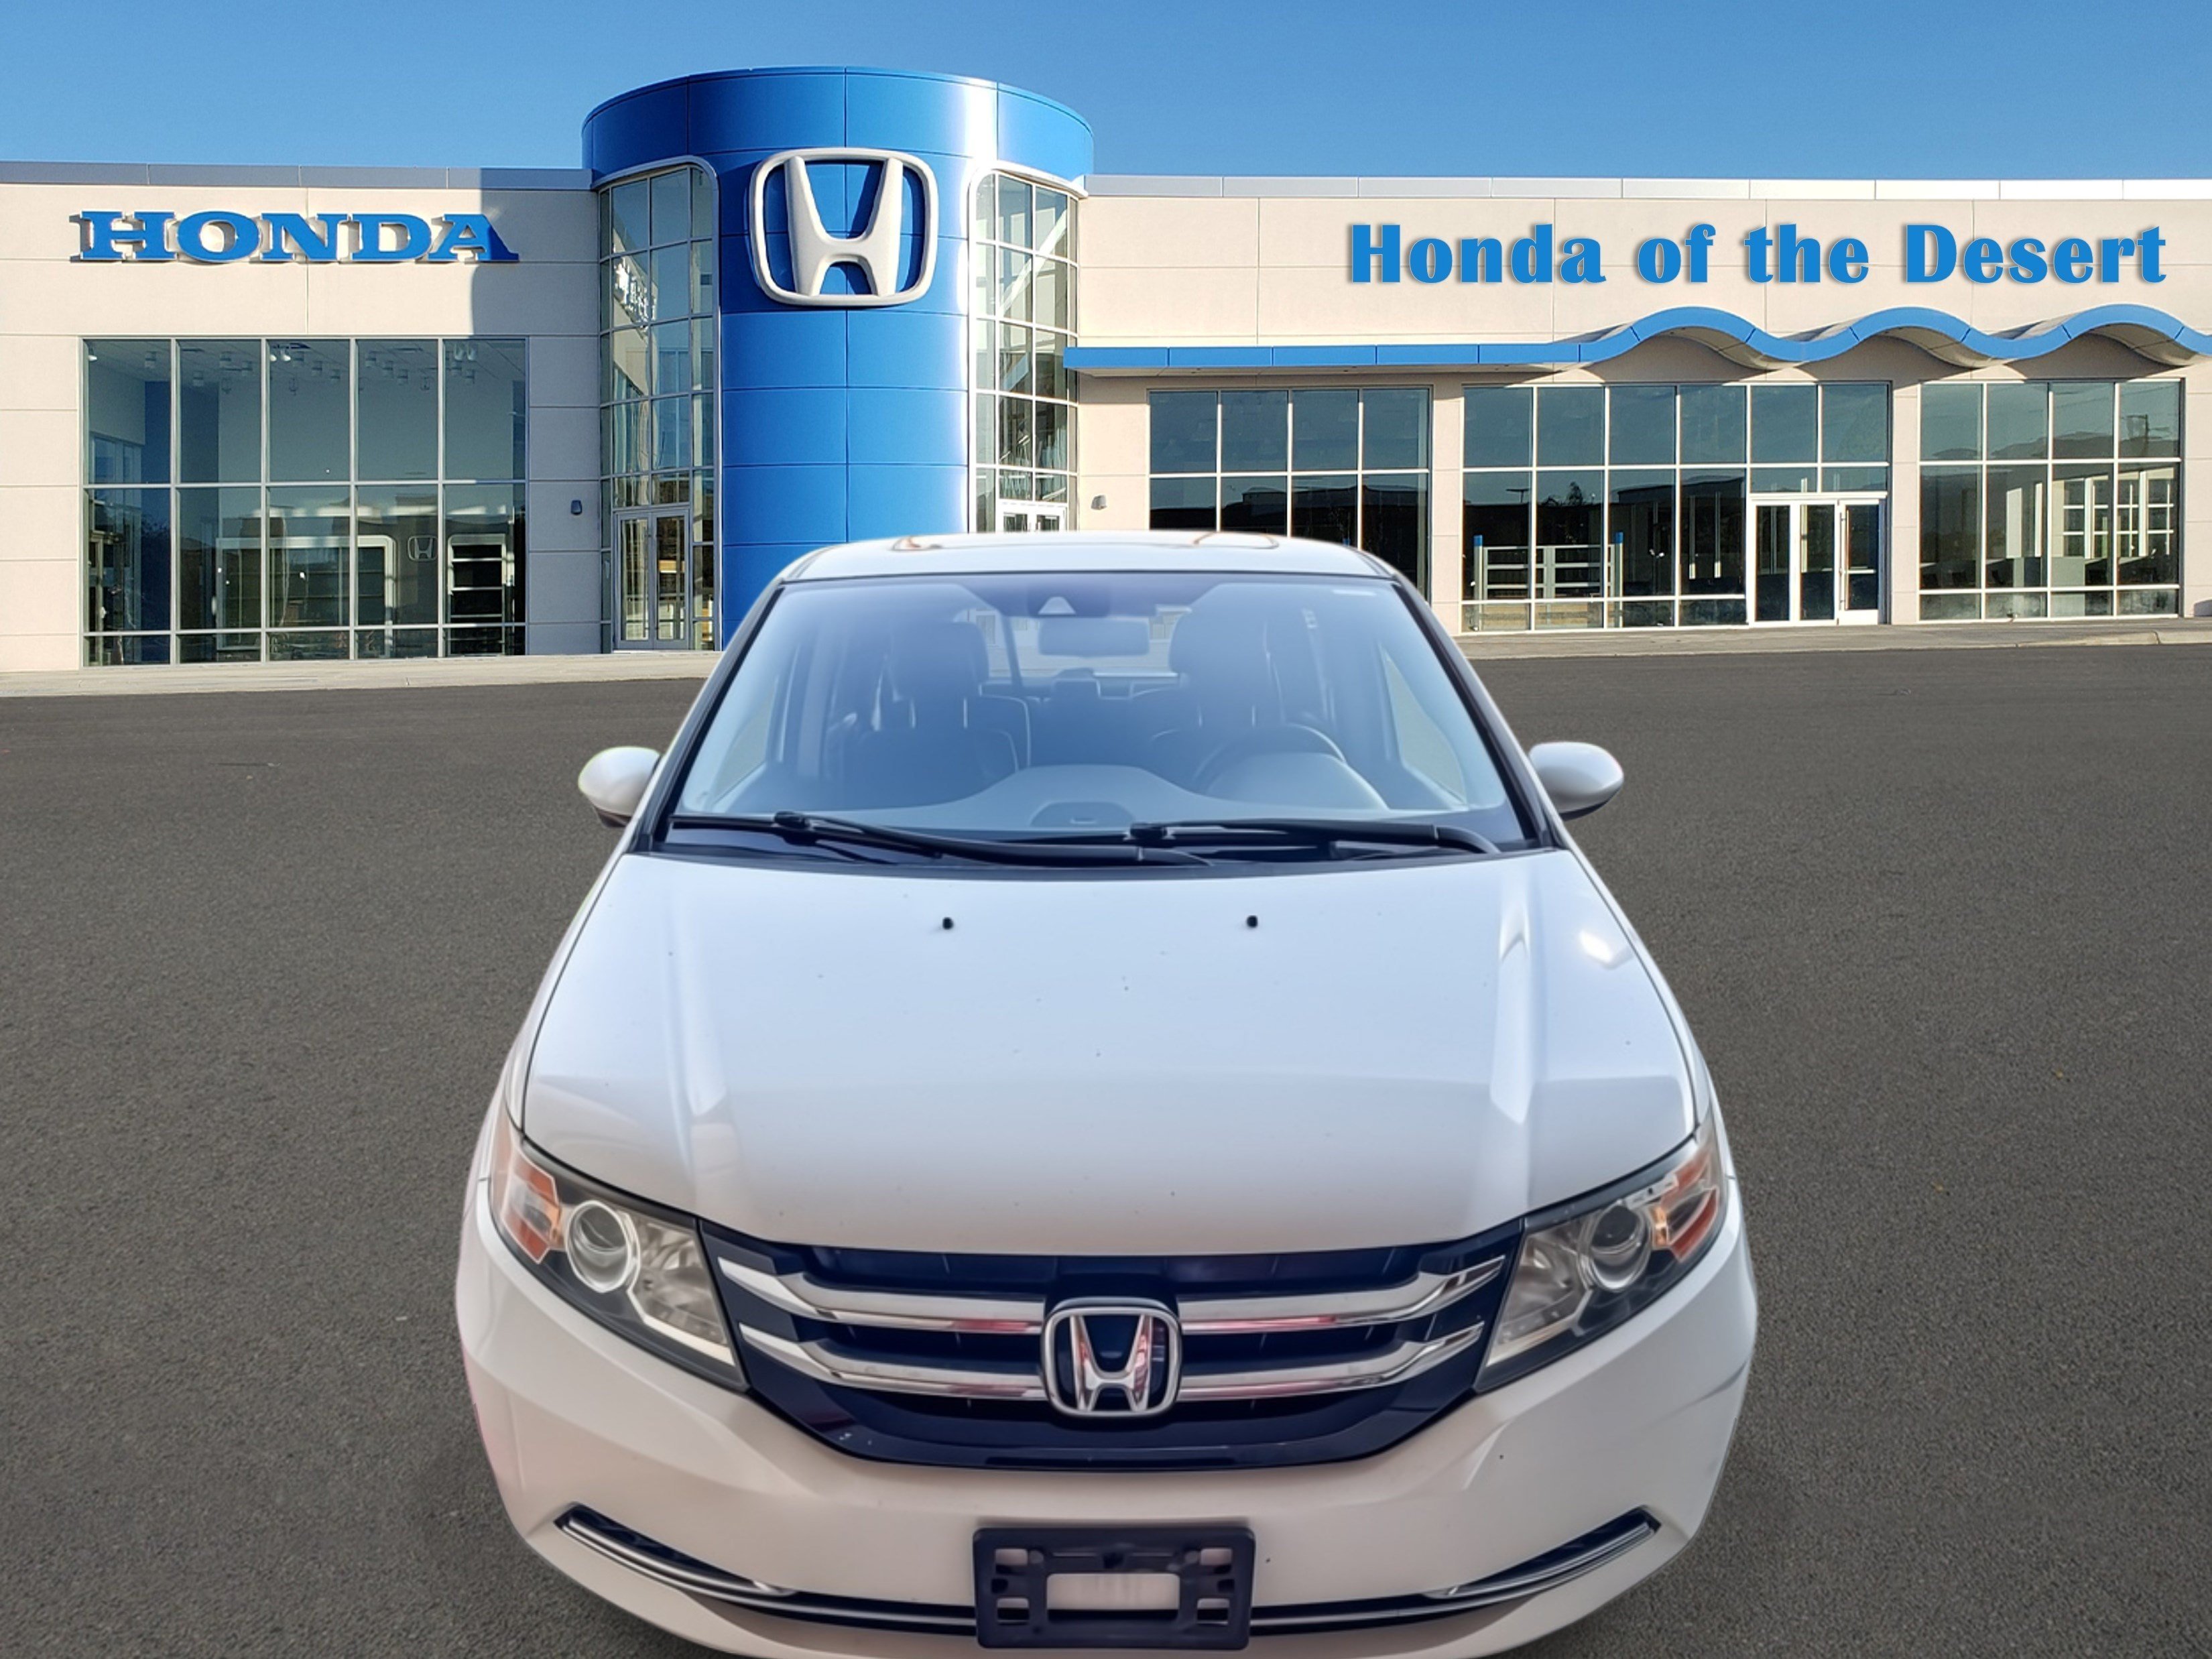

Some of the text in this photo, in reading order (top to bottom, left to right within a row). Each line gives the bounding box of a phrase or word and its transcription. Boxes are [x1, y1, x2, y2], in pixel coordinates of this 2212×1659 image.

[78, 210, 519, 261] HONDA
[1351, 223, 2166, 284] Honda of the Desert
